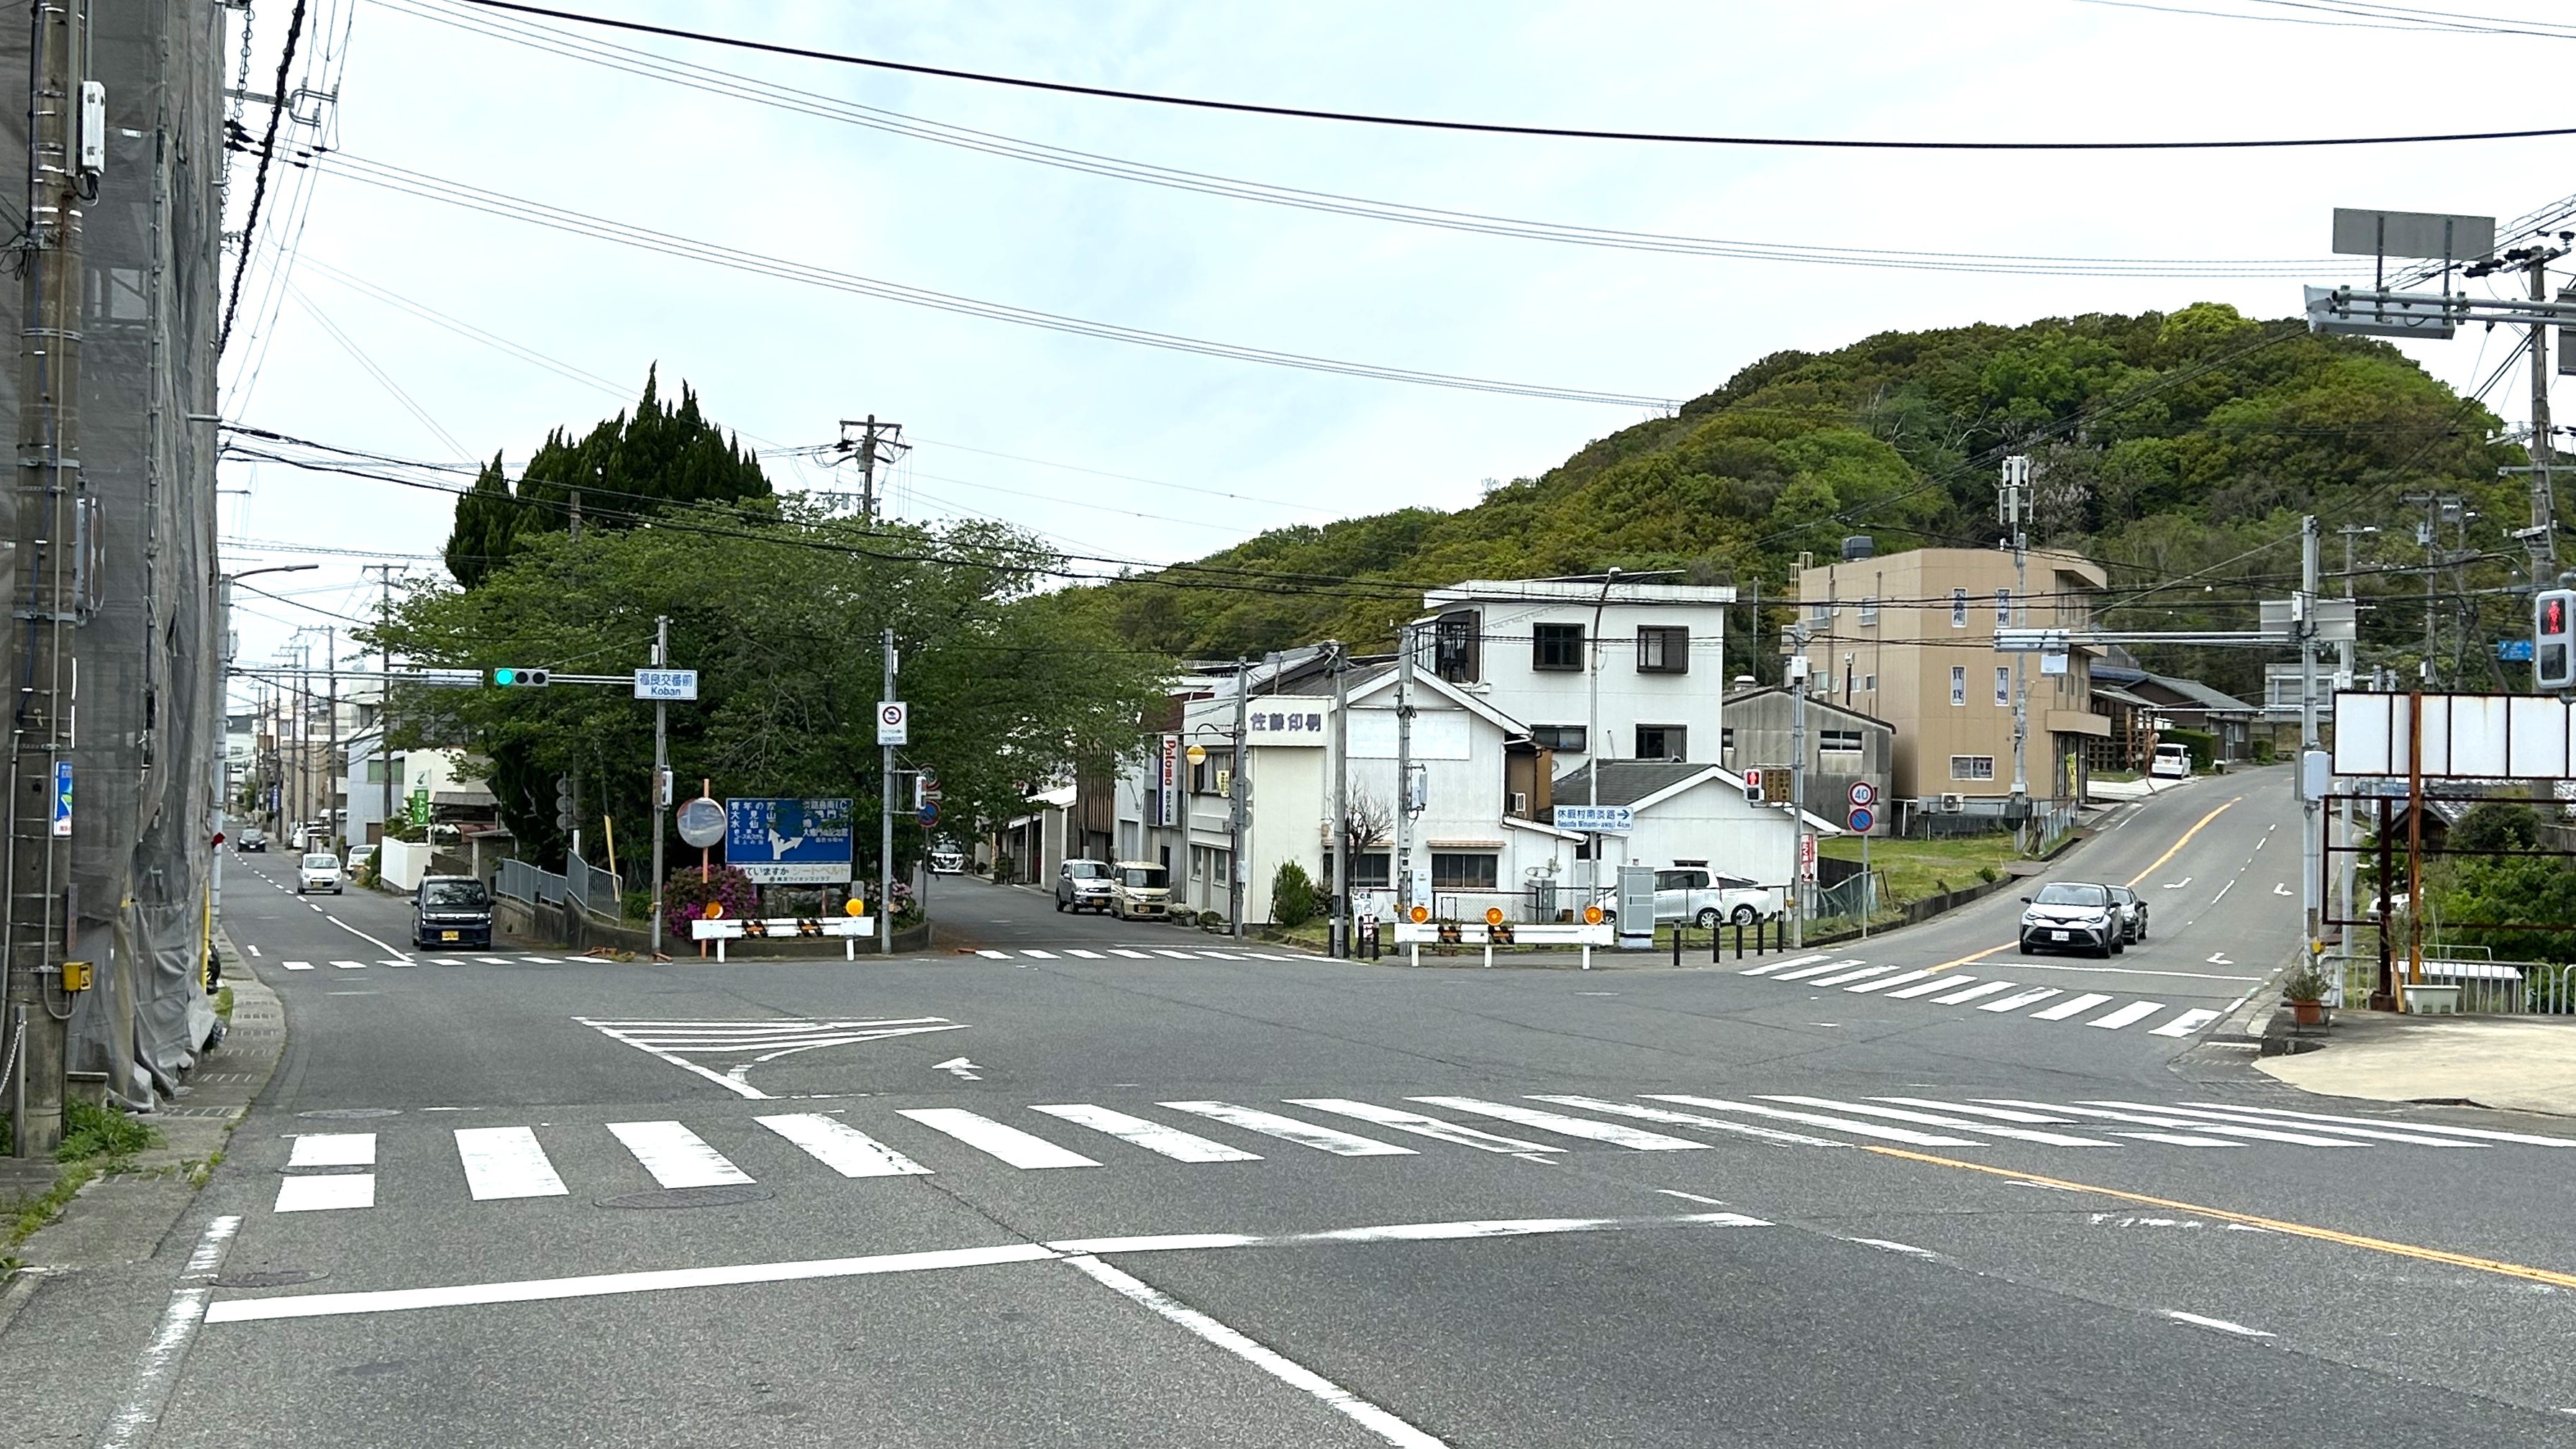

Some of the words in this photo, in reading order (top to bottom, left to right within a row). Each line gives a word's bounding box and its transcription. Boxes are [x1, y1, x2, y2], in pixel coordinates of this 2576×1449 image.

[640, 673, 693, 686] 福良交番前
[651, 686, 681, 696] Koban
[1165, 740, 1176, 786] Paloma
[1854, 789, 1869, 800] 40
